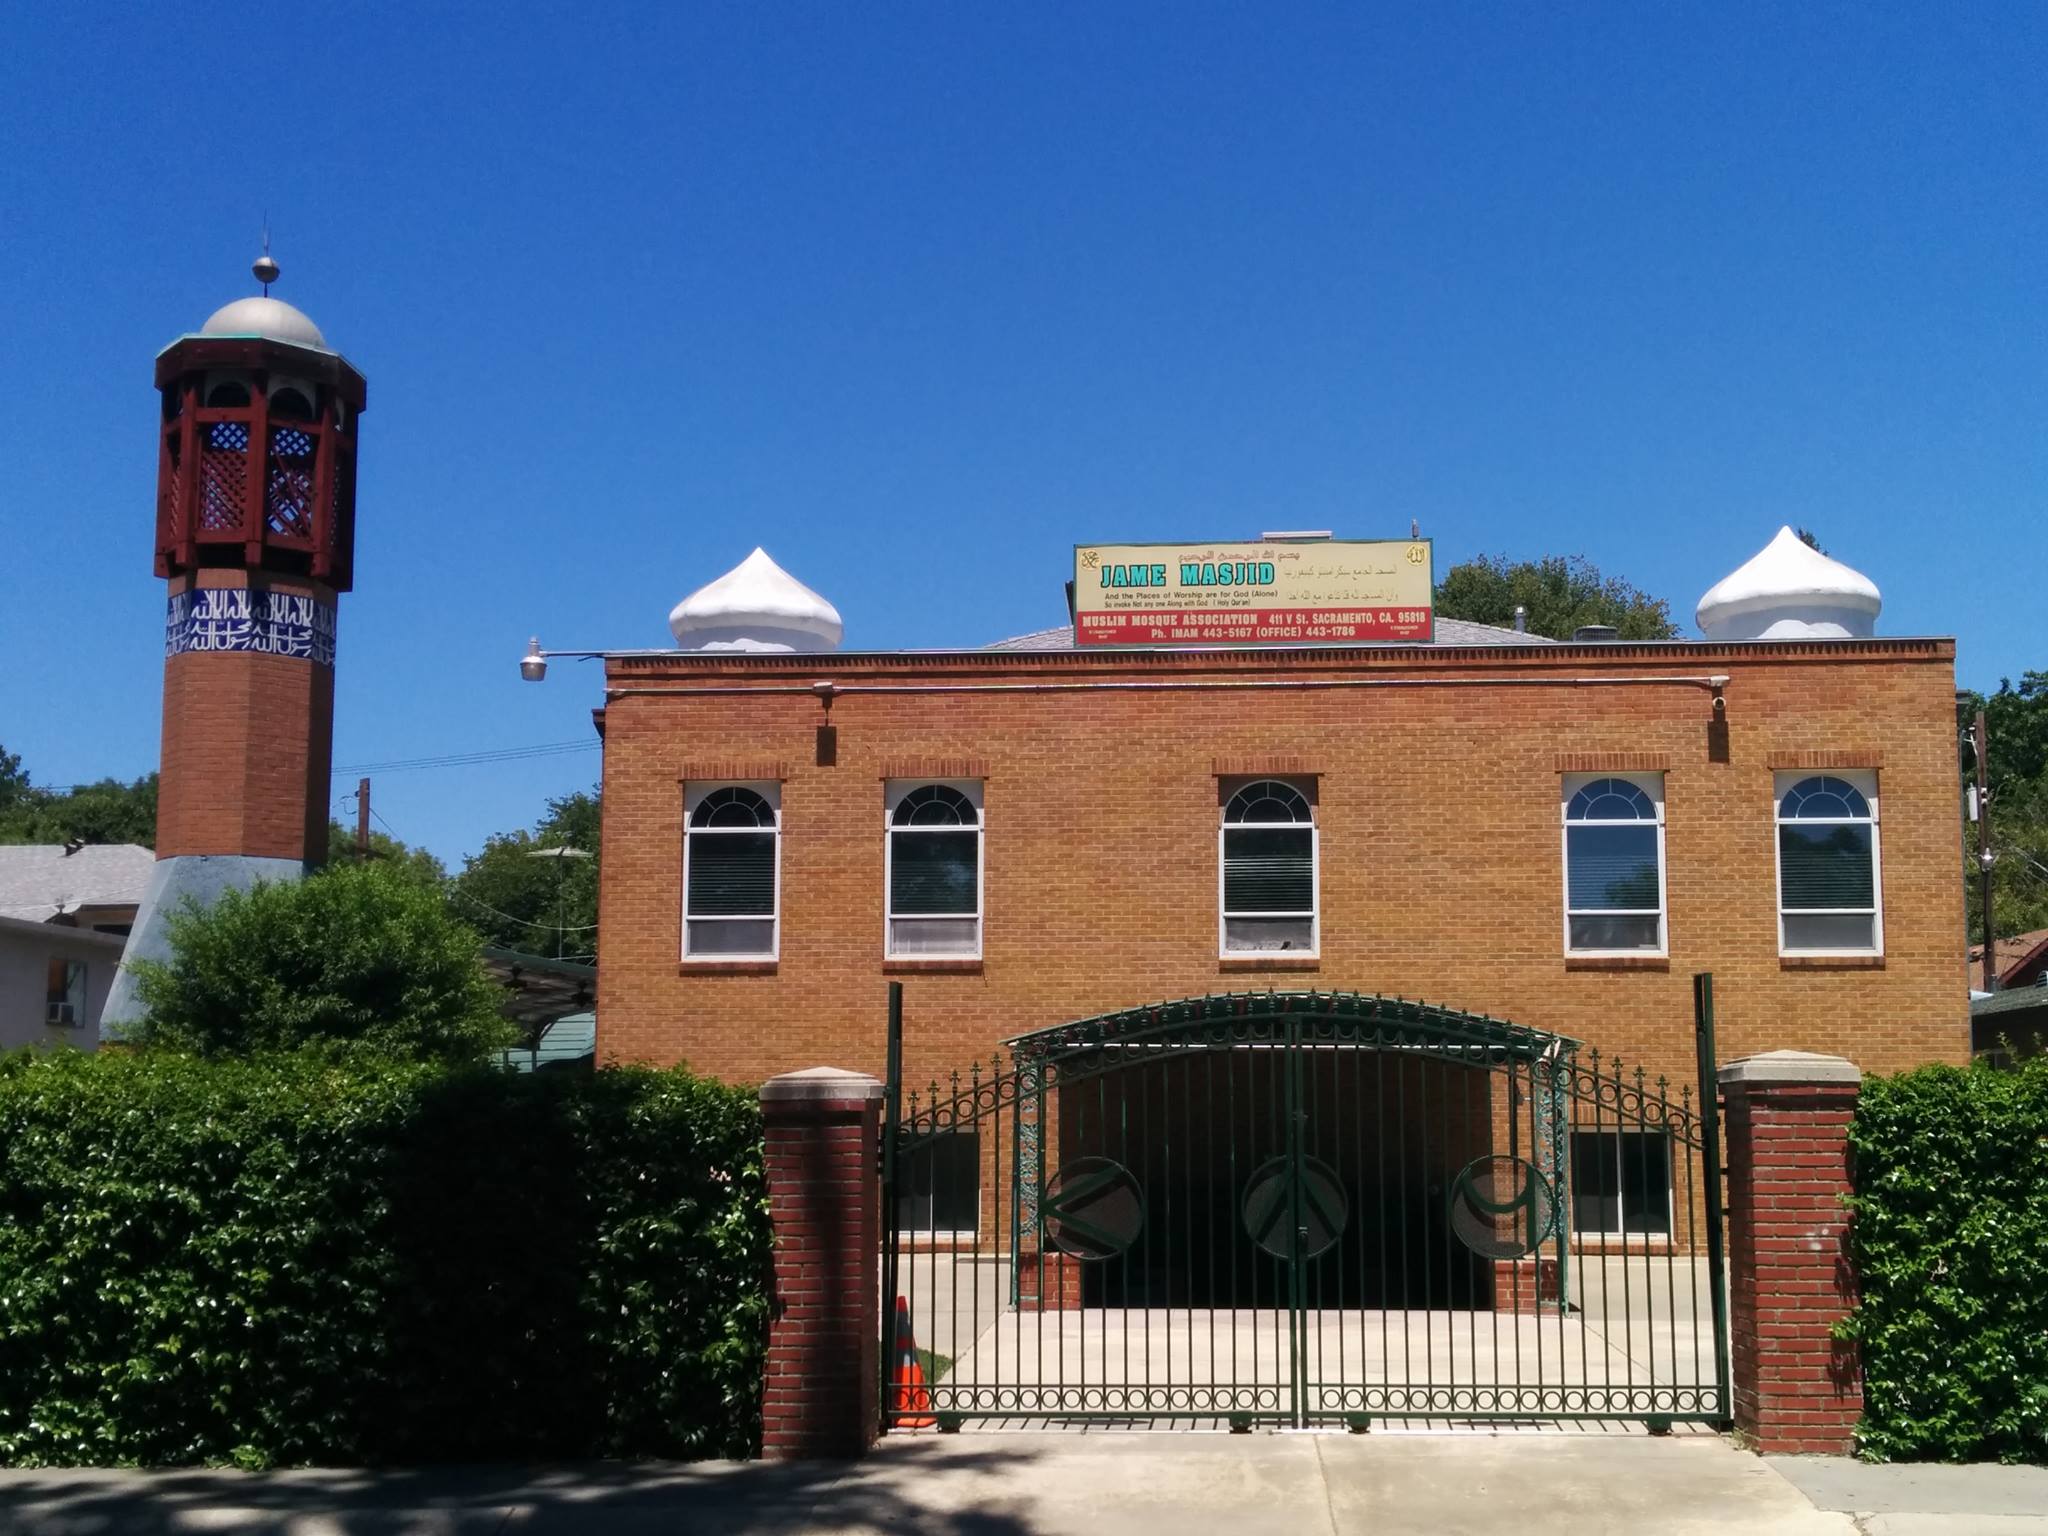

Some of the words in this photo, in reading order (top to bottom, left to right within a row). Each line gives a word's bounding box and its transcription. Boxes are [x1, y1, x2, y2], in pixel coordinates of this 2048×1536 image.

[1100, 564, 1166, 588] JAME
[1180, 562, 1275, 586] MASJID
[1174, 591, 1202, 600] Worship
[1233, 590, 1249, 598] God
[1251, 590, 1278, 598] (Alone)
[1082, 615, 1127, 627] MUSLIM
[1131, 615, 1178, 627] MOSQUE
[1182, 613, 1258, 625] ASSOCIATION
[1268, 613, 1283, 625] 411
[1286, 613, 1293, 624] V
[1295, 613, 1309, 625] St.
[1312, 612, 1376, 626] SACRAMENTO,
[1379, 611, 1395, 623] CA.
[1398, 611, 1426, 623] 95818
[1151, 628, 1167, 638] Ph.
[1171, 628, 1198, 638] IMAM
[1203, 627, 1252, 638] 443-5167
[1256, 626, 1302, 639] (OFFICE)
[1305, 626, 1356, 637] 443-1786
